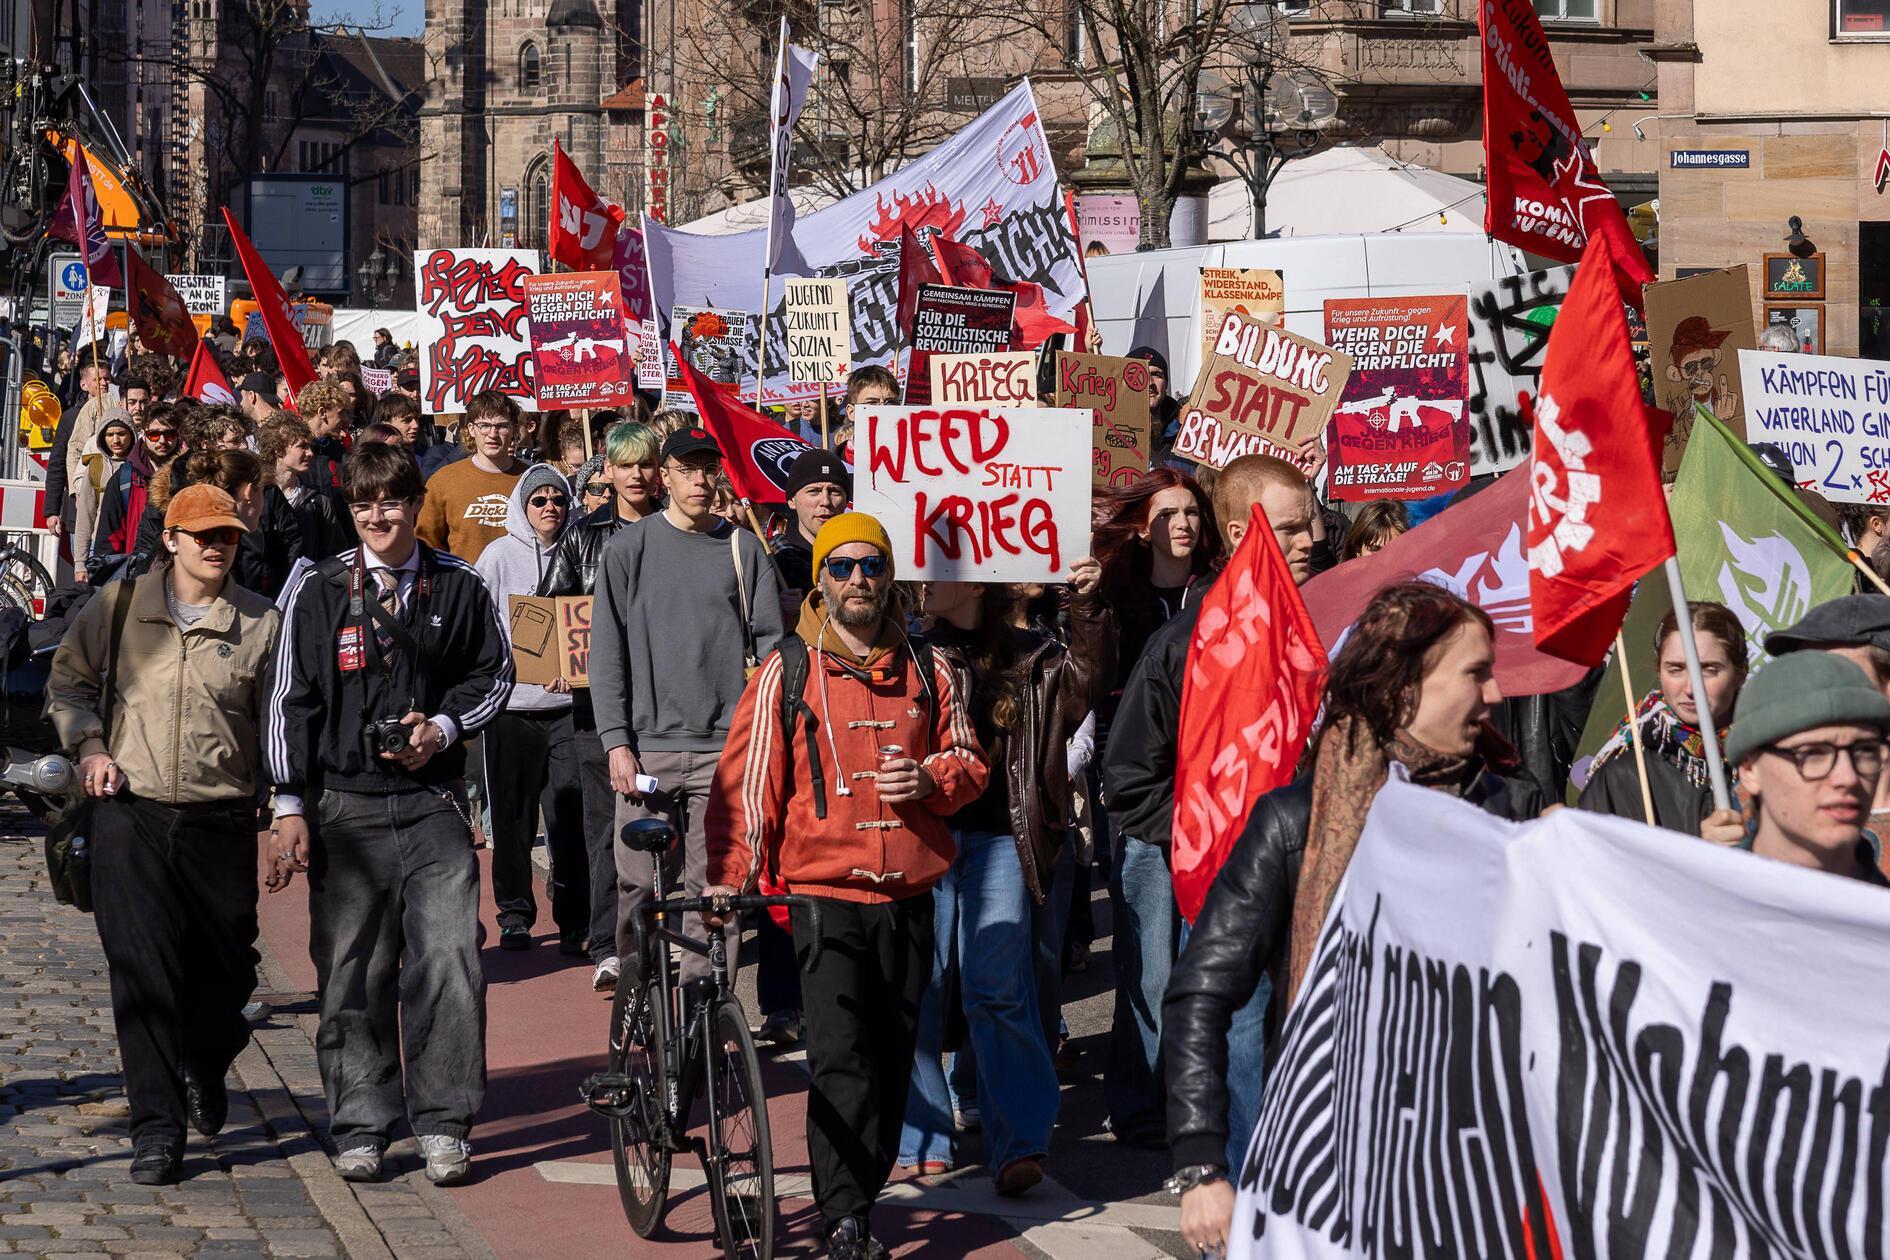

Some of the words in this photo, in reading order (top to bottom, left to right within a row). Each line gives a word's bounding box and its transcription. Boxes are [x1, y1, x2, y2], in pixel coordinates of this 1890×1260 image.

[1673, 152, 1747, 166] Johannesgasse
[1204, 269, 1239, 280] STREIK,
[1204, 280, 1272, 292] WIDERSTAND,
[1774, 281, 1813, 292] SALATE
[189, 290, 202, 300] AN
[205, 290, 220, 300] DIE
[530, 294, 562, 304] WEHR
[566, 291, 595, 302] DICH
[786, 284, 833, 306] JUGEND
[923, 290, 972, 301] GEMEINSAM
[973, 294, 1011, 305] KÄMPFEN
[1204, 290, 1282, 300] KLASSENKAMPF
[531, 302, 572, 313] GEGEN
[574, 301, 593, 311] DIE
[1331, 309, 1343, 317] Für
[1371, 307, 1399, 316] Zukunft
[1407, 307, 1431, 316] gegen
[532, 309, 615, 323] WEHRPFLICHT!
[719, 316, 744, 326] FRAUEN
[787, 312, 840, 331] ZUKUNFT
[918, 309, 942, 325] FÜR
[945, 313, 966, 326] DIE
[1331, 316, 1351, 324] Krieg
[732, 327, 743, 336] DIE
[917, 325, 1009, 343] SOZIALISTISCHE
[1331, 327, 1380, 342] WEHR
[1385, 325, 1428, 340] DICH
[713, 337, 743, 346] STRASSE
[789, 335, 844, 358] SOZIAL-
[1332, 342, 1391, 356] GEGEN
[1395, 339, 1425, 355] DIE
[1214, 312, 1334, 396] BILDUNG
[1350, 353, 1456, 371] EHRPFLICHT!
[791, 360, 833, 382] ISMUS
[540, 385, 554, 393] AM
[581, 382, 597, 390] AUF
[941, 358, 1036, 402] KRIEG
[1060, 357, 1117, 412] Krieg
[1864, 370, 1890, 405] FÜ
[1206, 370, 1311, 441] STATT
[1341, 434, 1397, 450] GEGEN
[1401, 424, 1450, 449] KRIEG
[869, 409, 1010, 483] WEED
[1334, 465, 1354, 476] AM
[1357, 464, 1392, 474] TAG-X
[1395, 462, 1418, 473] AUF
[1823, 440, 1850, 490] 2
[982, 462, 1063, 491] STATT
[1335, 474, 1354, 485] DIE
[1364, 485, 1436, 494] internationale-jugend.de
[914, 491, 1060, 572] KRIEG
[564, 601, 590, 627] IC
